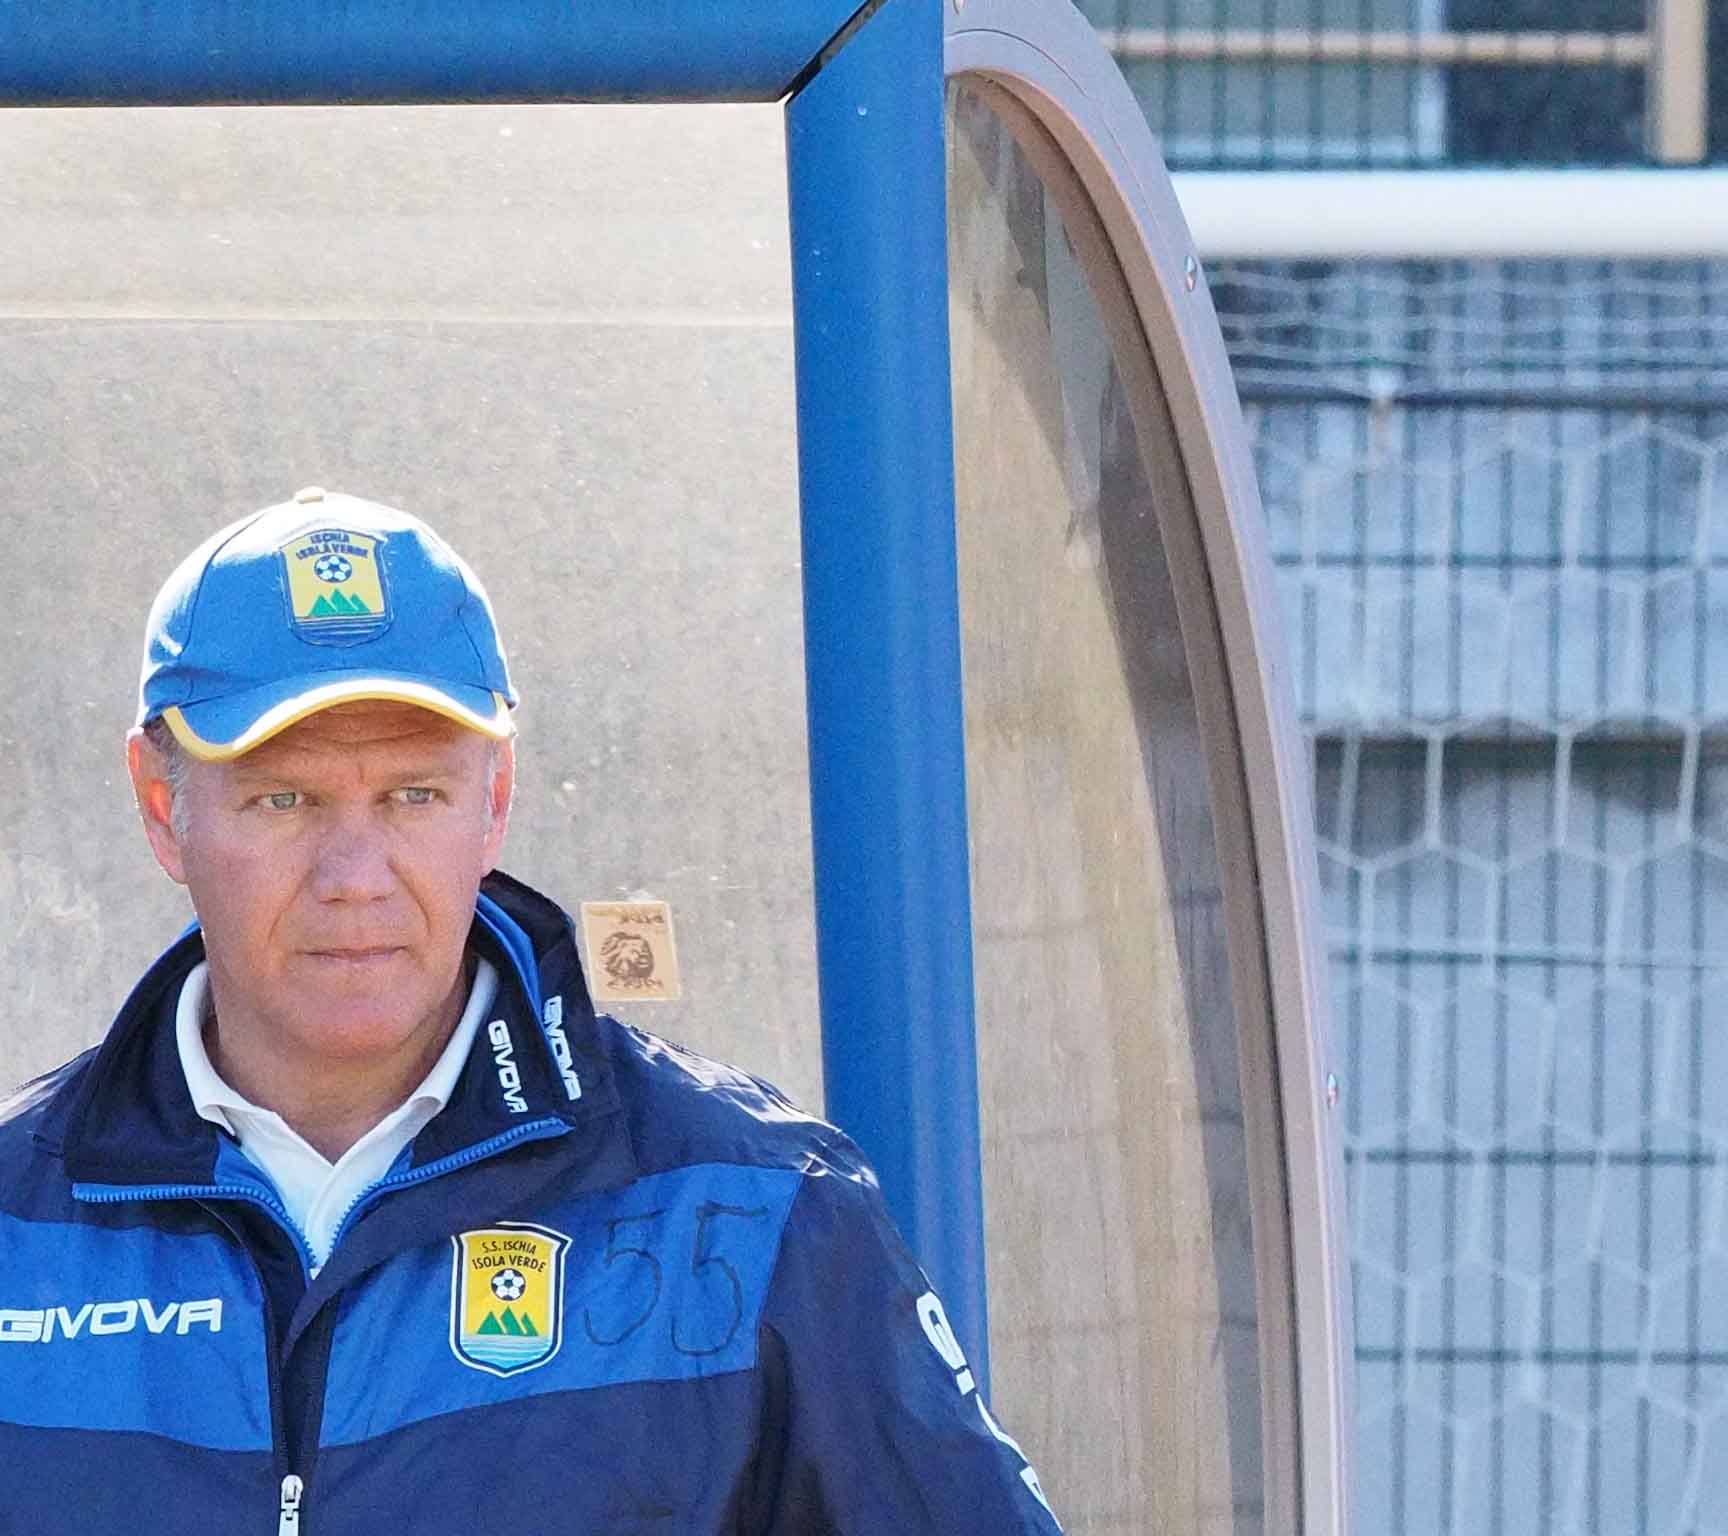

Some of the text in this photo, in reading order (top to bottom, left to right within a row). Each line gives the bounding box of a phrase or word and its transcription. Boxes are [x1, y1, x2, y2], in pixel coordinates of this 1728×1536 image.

[487, 1019, 529, 1113] GIVOVA
[503, 1240, 537, 1255] ISCHIA
[472, 1255, 547, 1272] ISOLA VERDE
